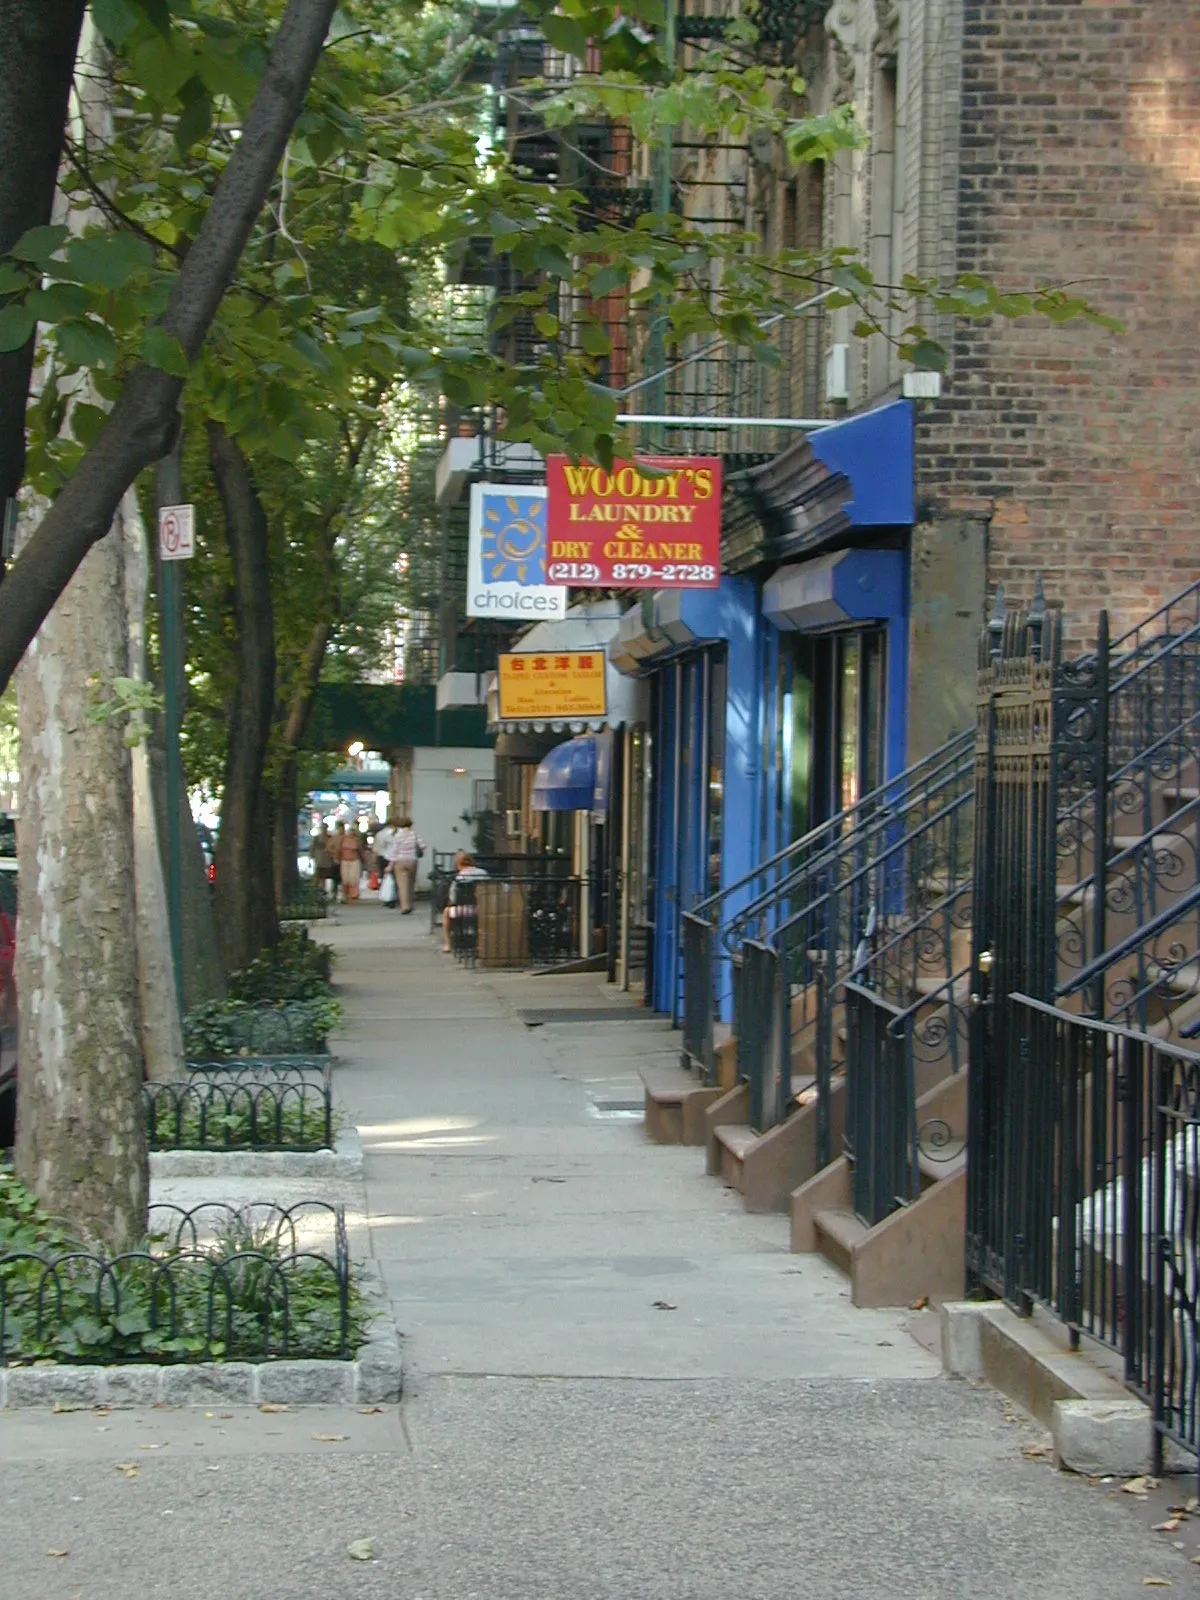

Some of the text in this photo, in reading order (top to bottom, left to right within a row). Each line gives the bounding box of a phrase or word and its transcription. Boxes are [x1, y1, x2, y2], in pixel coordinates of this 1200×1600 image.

[563, 466, 712, 499] WOODY'S
[569, 504, 696, 522] LAUNDRY
[615, 524, 644, 539] &
[551, 541, 704, 560] DRY CLEANER
[548, 563, 716, 581] (212) 879-2728
[474, 590, 559, 611] choices
